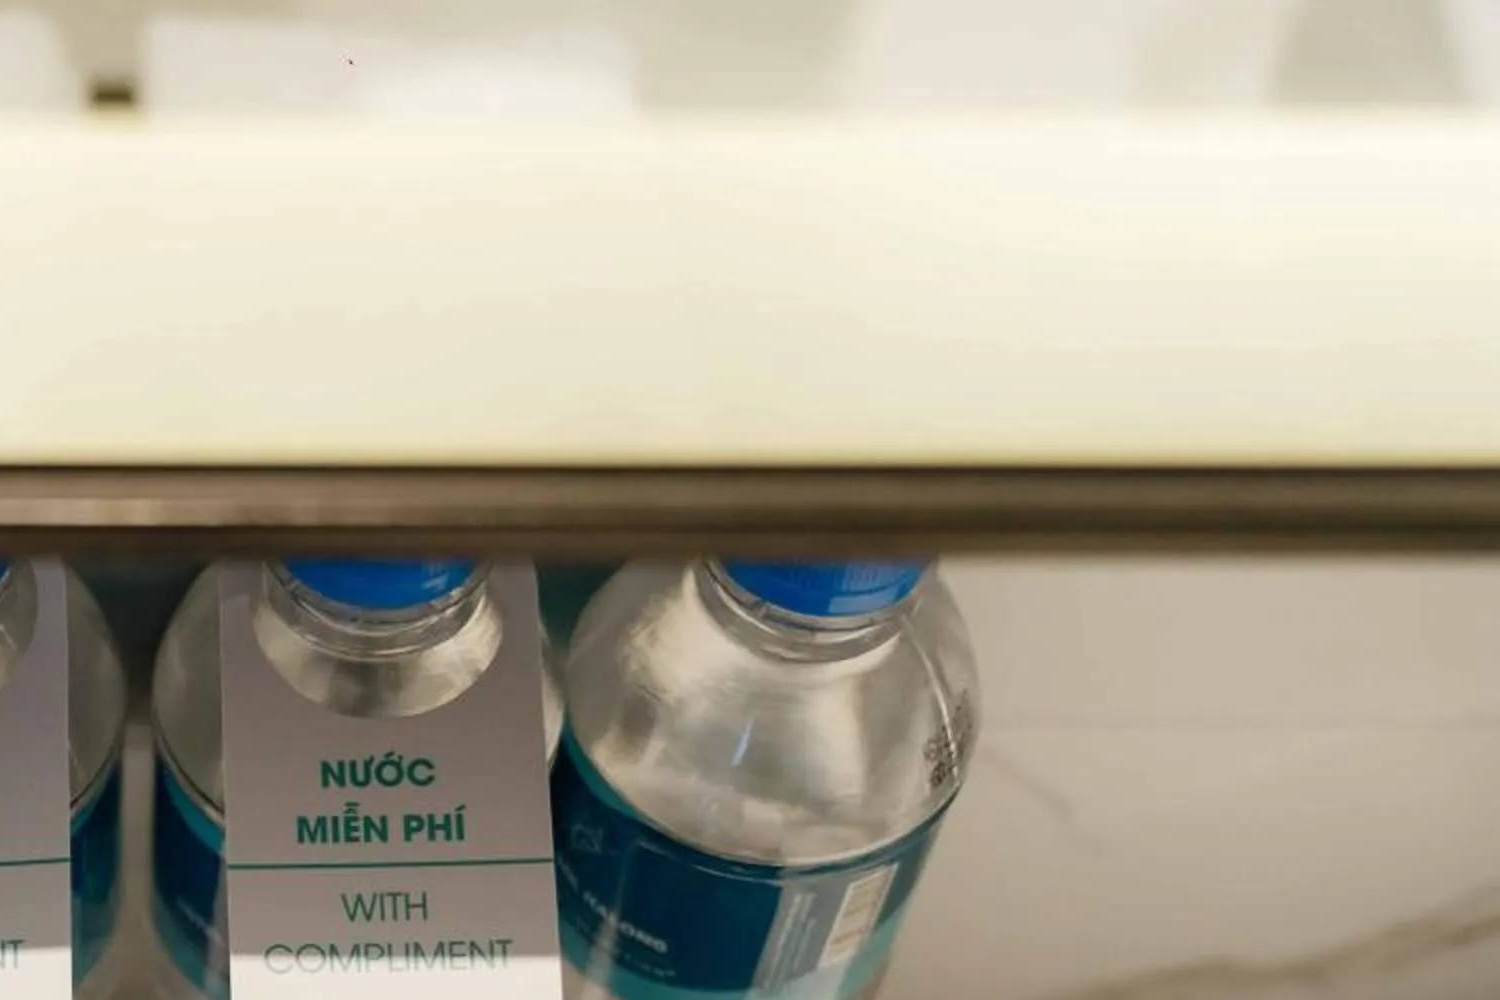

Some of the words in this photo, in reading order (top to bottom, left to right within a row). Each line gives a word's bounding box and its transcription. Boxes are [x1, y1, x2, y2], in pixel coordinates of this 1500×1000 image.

[320, 752, 436, 789] NƯỚC
[296, 802, 389, 844] MIỄN
[403, 805, 466, 842] PHÍ
[341, 891, 429, 922] WITH
[263, 938, 514, 974] COMPLIMENT
